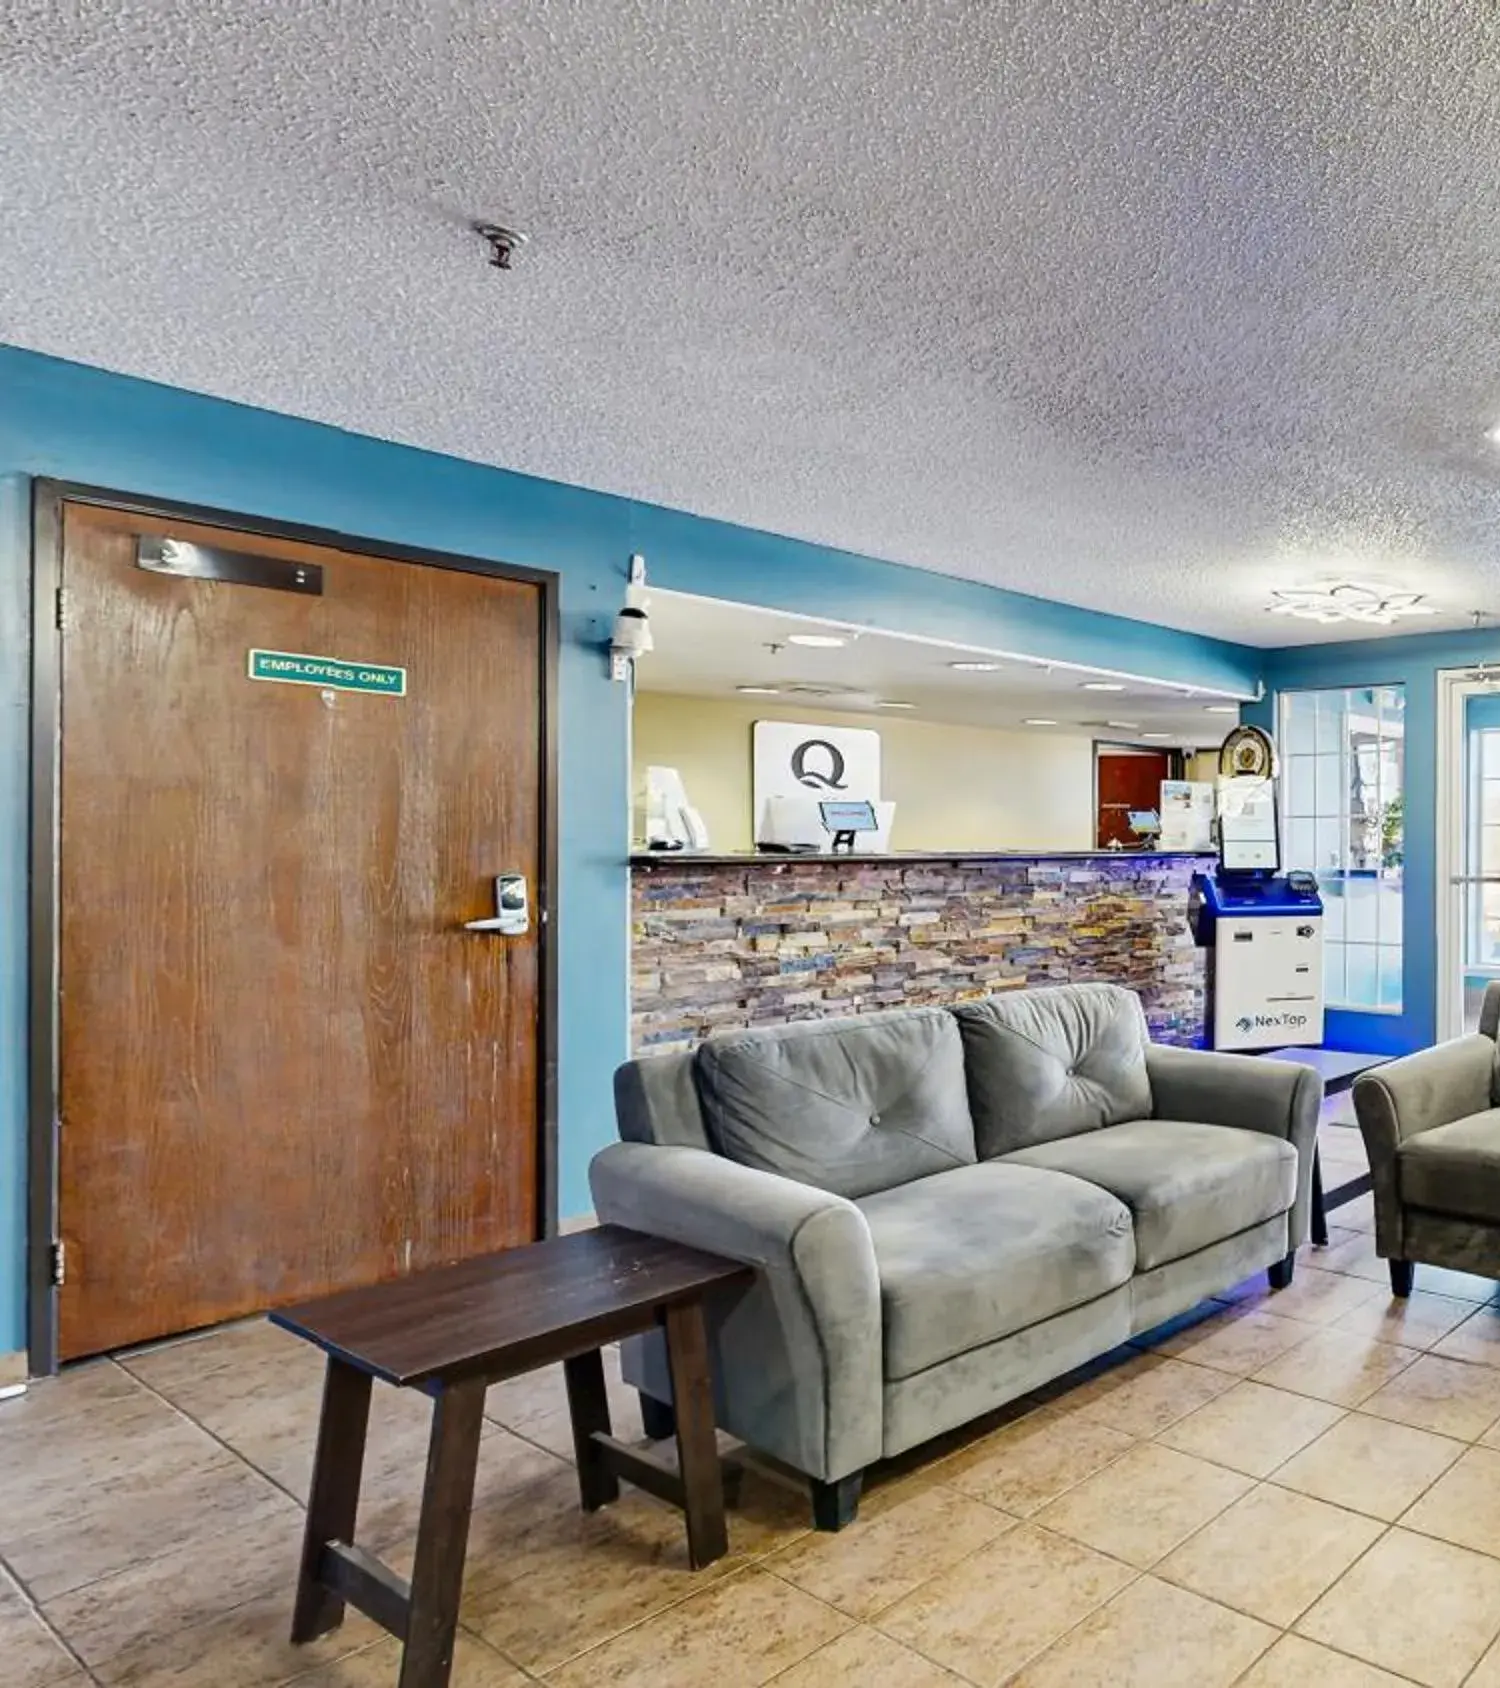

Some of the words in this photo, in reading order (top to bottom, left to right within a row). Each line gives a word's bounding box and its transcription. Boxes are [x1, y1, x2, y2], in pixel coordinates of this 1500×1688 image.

[259, 657, 354, 681] EMPLOYEES
[359, 671, 397, 685] ONLY
[791, 739, 848, 790] Q
[1255, 1014, 1307, 1027] NexTop
